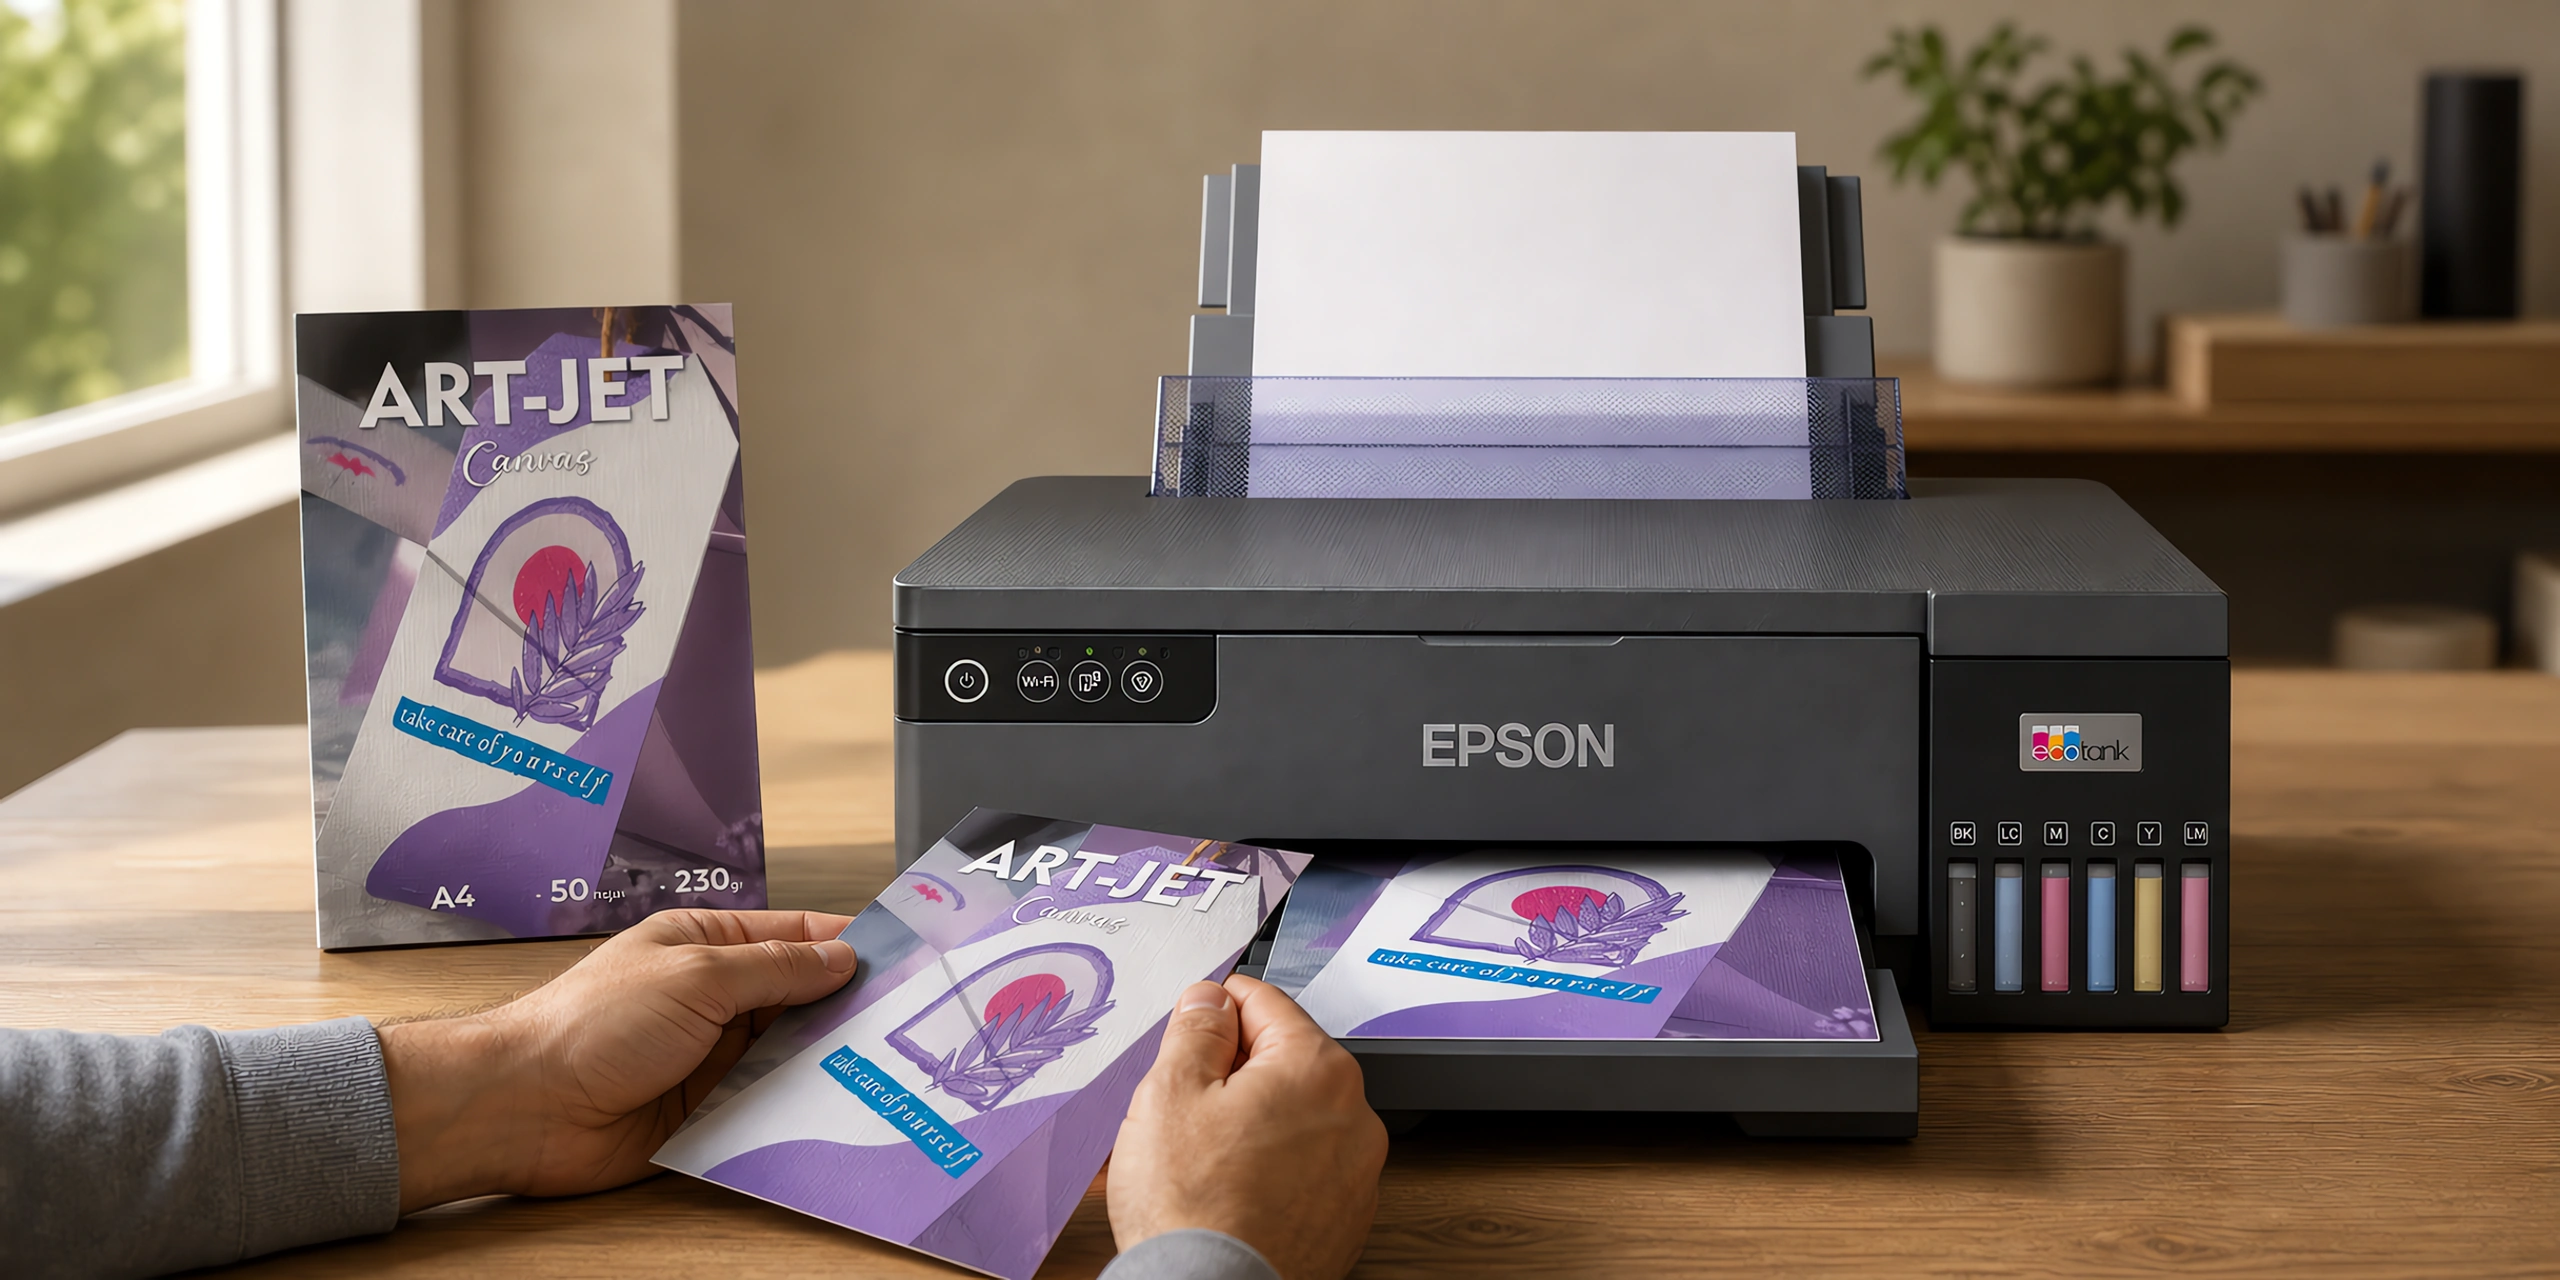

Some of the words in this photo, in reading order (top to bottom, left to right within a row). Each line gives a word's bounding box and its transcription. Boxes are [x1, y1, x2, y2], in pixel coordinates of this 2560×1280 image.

[358, 355, 684, 428] ART-JET
[462, 441, 597, 487] Canvas
[437, 722, 476, 747] care
[1422, 722, 1615, 768] EPSON
[2032, 740, 2130, 761] ecotank
[1954, 827, 1973, 840] BK
[2002, 827, 2018, 840] LC
[2050, 827, 2062, 840] M
[2098, 827, 2109, 840] C
[2144, 827, 2155, 840] Y
[2187, 827, 2206, 840] LM
[957, 839, 1250, 912] ART-JET
[430, 885, 475, 910] A4
[550, 877, 589, 903] 50
[1012, 895, 1129, 935] Canvas
